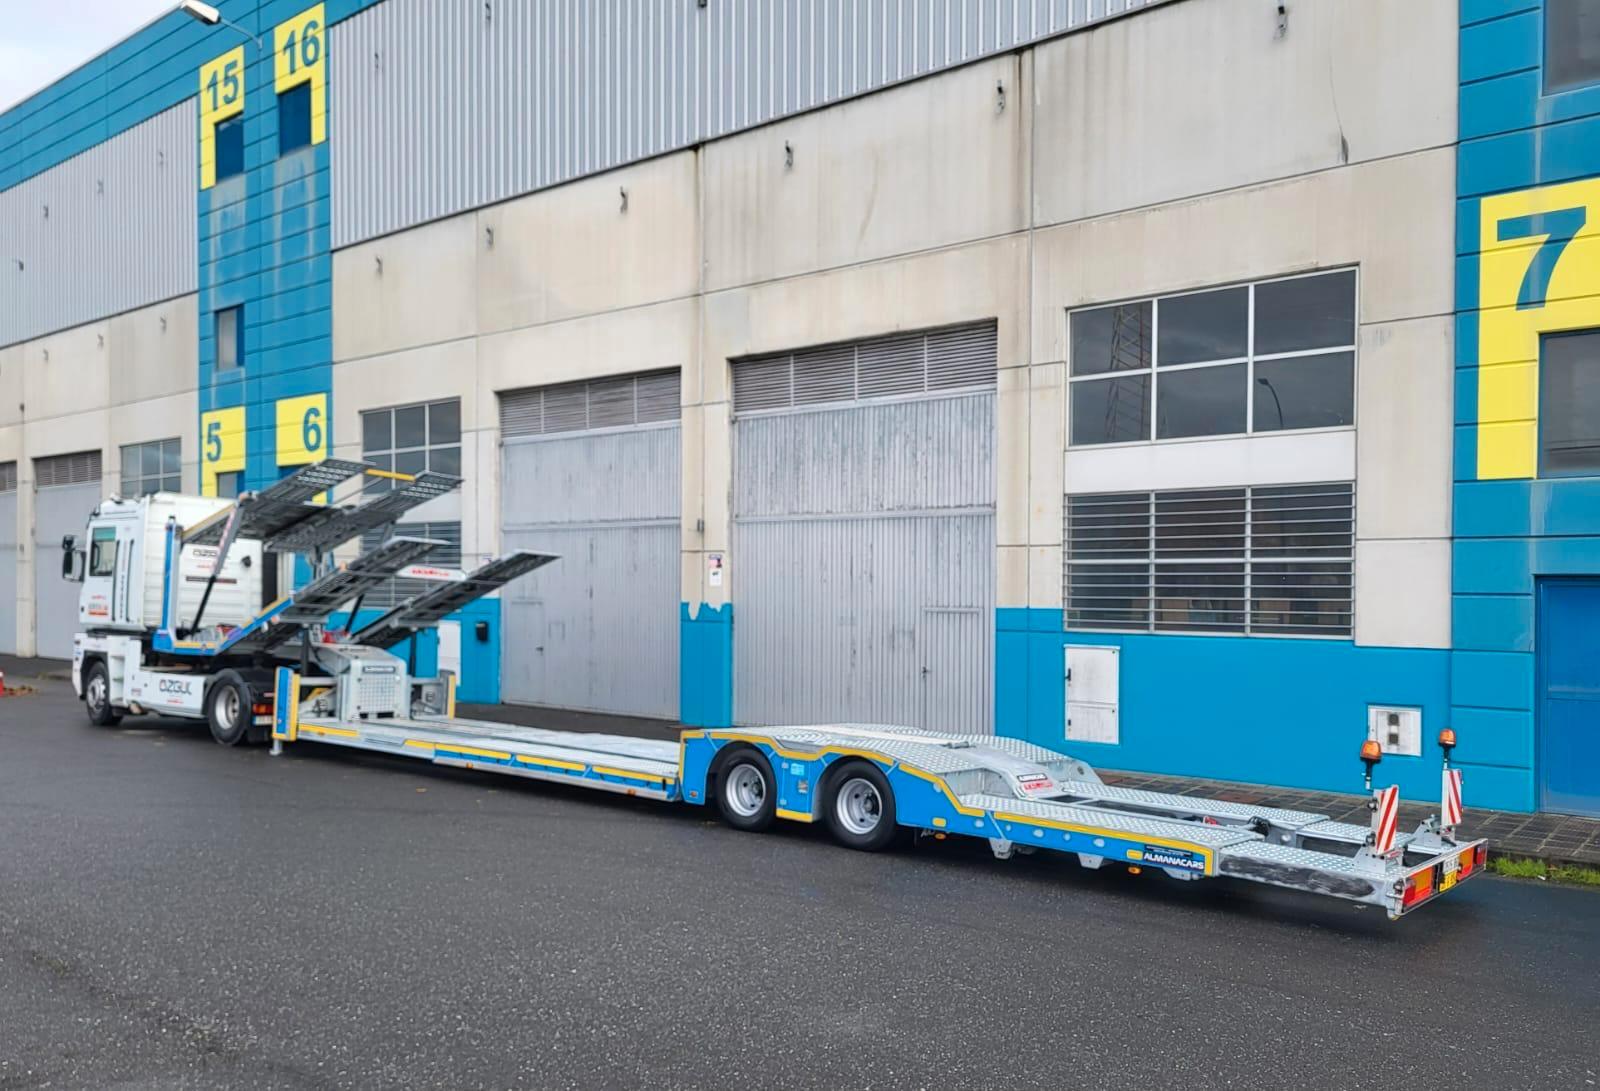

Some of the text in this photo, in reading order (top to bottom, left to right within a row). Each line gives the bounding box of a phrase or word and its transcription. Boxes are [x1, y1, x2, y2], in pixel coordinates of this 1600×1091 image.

[283, 20, 320, 75] 16
[207, 60, 239, 111] 15
[1497, 206, 1586, 311] 7
[206, 422, 222, 462] 5
[303, 407, 322, 452] 6
[1143, 852, 1204, 870] ALMANACARS
